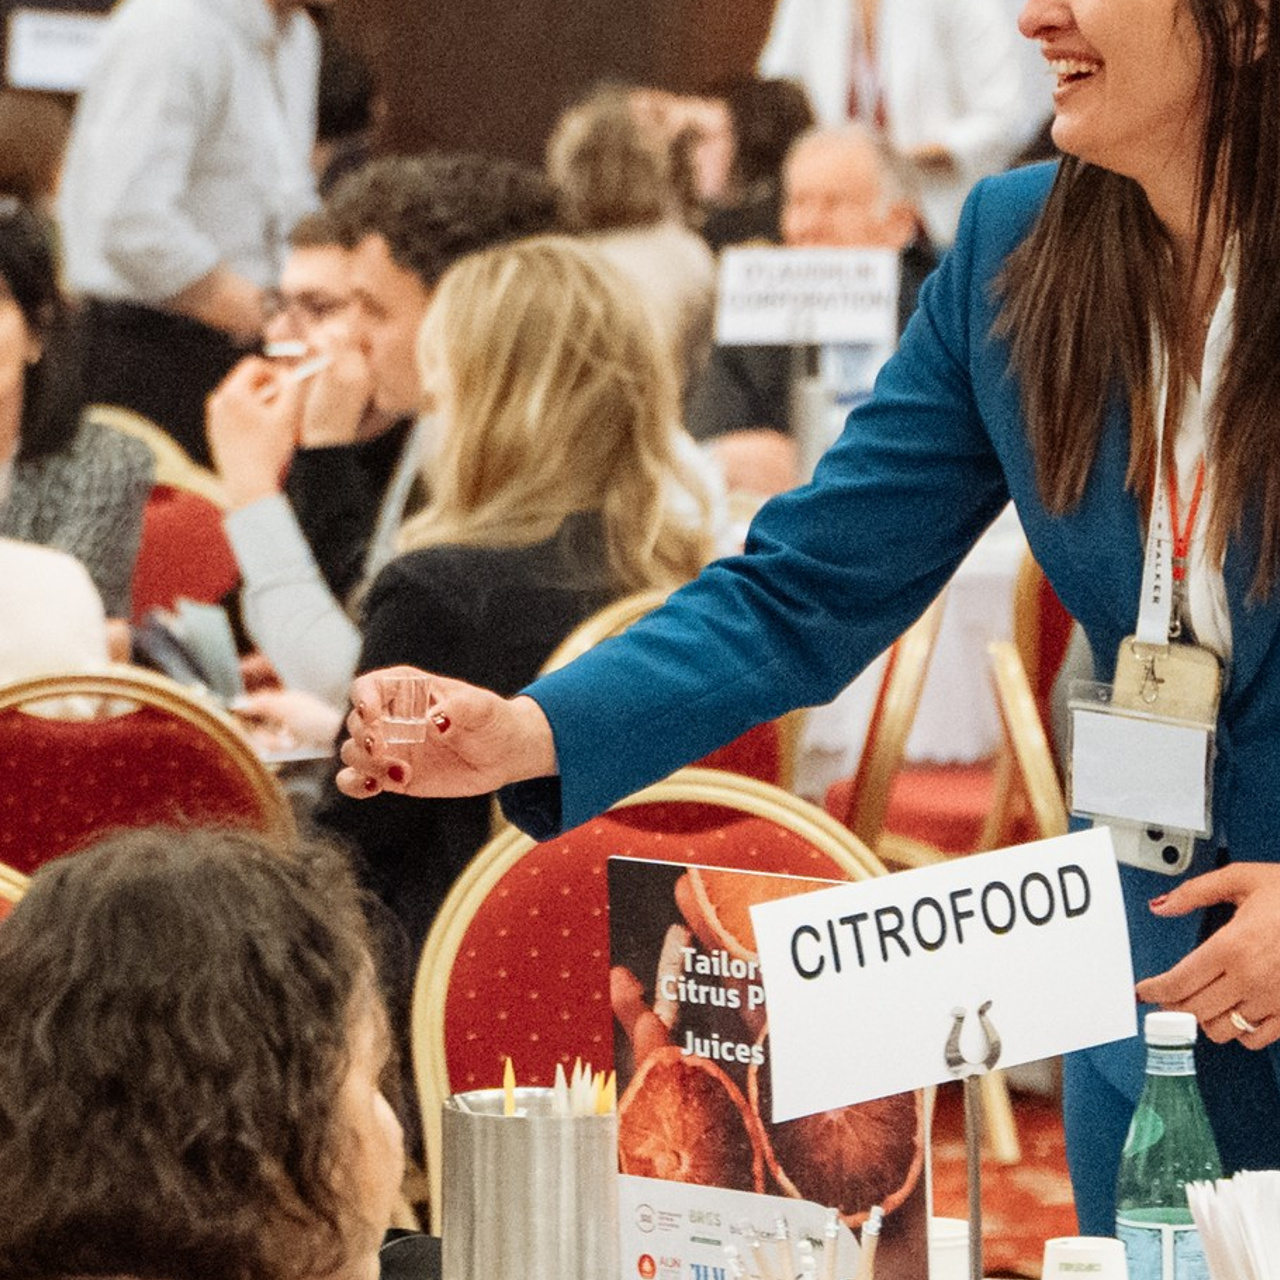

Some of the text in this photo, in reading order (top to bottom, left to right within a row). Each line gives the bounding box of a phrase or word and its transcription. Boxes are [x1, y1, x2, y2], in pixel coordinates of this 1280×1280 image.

[790, 863, 1092, 980] CITROFOOD
[680, 946, 761, 980] Tailor
[660, 974, 766, 1011] Citrus P
[680, 1030, 765, 1066] Juices
